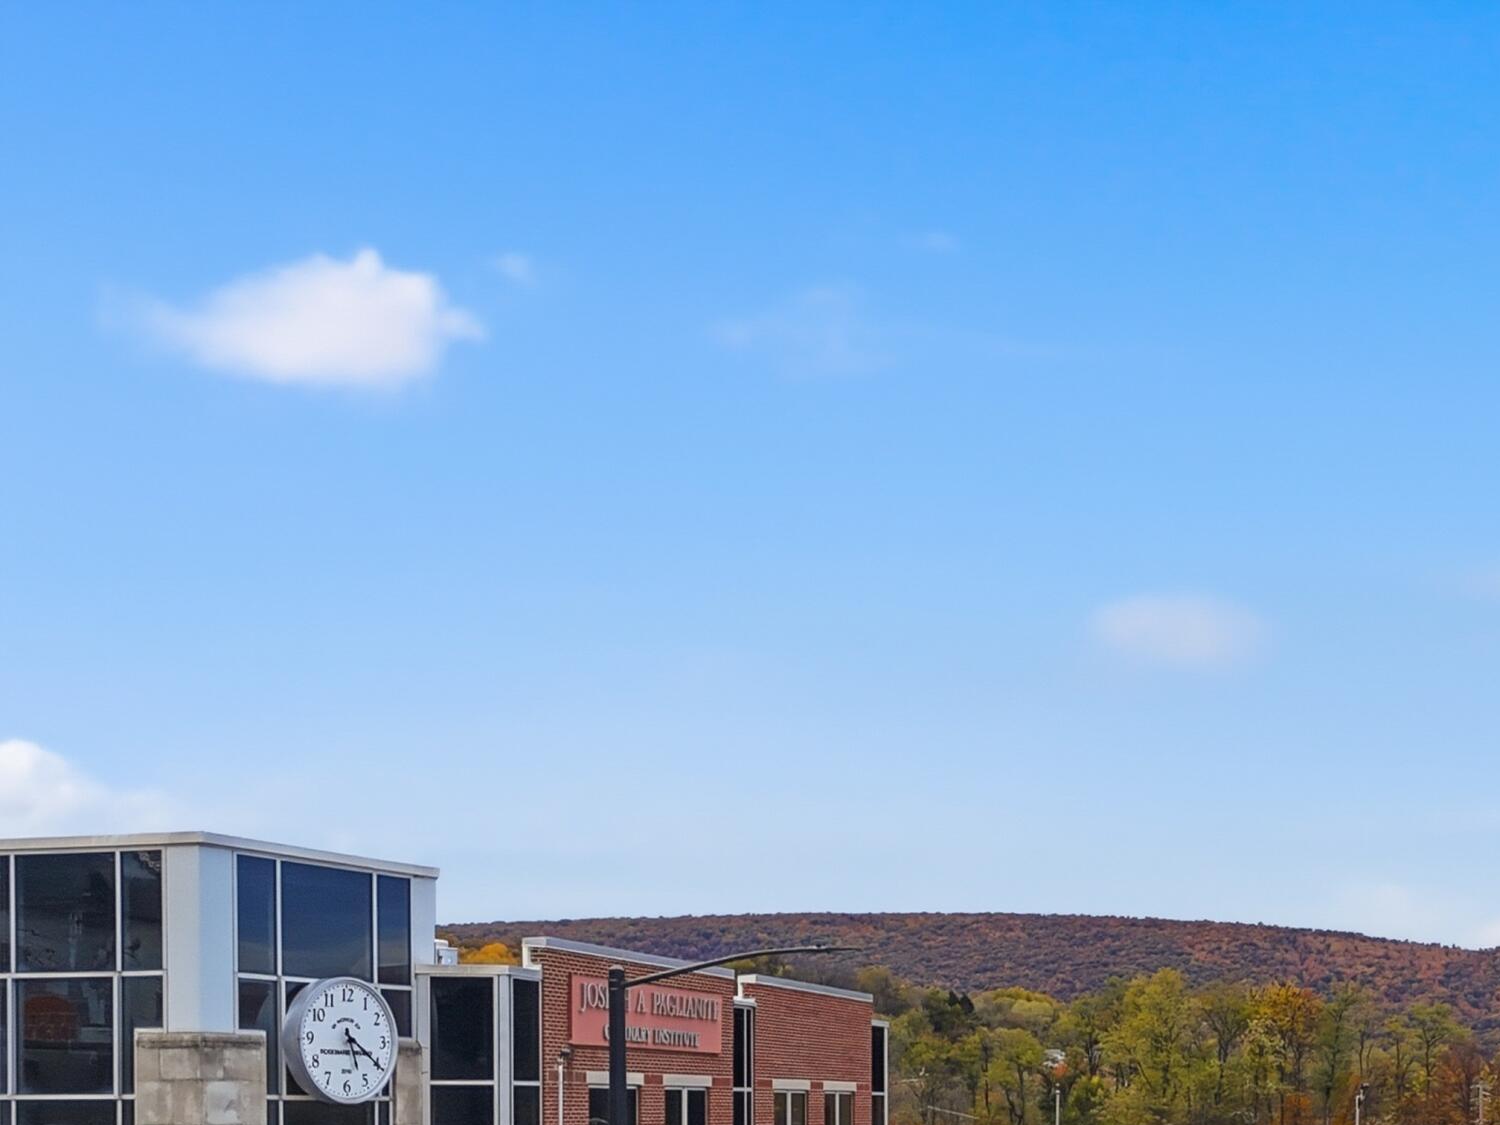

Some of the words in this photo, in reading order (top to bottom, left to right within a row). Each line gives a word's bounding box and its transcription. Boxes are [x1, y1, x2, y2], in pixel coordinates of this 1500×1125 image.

[324, 993, 334, 1008] 11
[342, 988, 354, 1002] 12
[637, 990, 646, 1013] A
[363, 997, 368, 1011] 1
[312, 1008, 325, 1022] 10
[374, 1012, 380, 1026] 2
[306, 1031, 314, 1044] 9
[379, 1036, 386, 1049] 3
[312, 1054, 319, 1068] 8
[324, 1071, 331, 1086] 7
[362, 1073, 368, 1087] 5
[343, 1080, 351, 1094] 6
